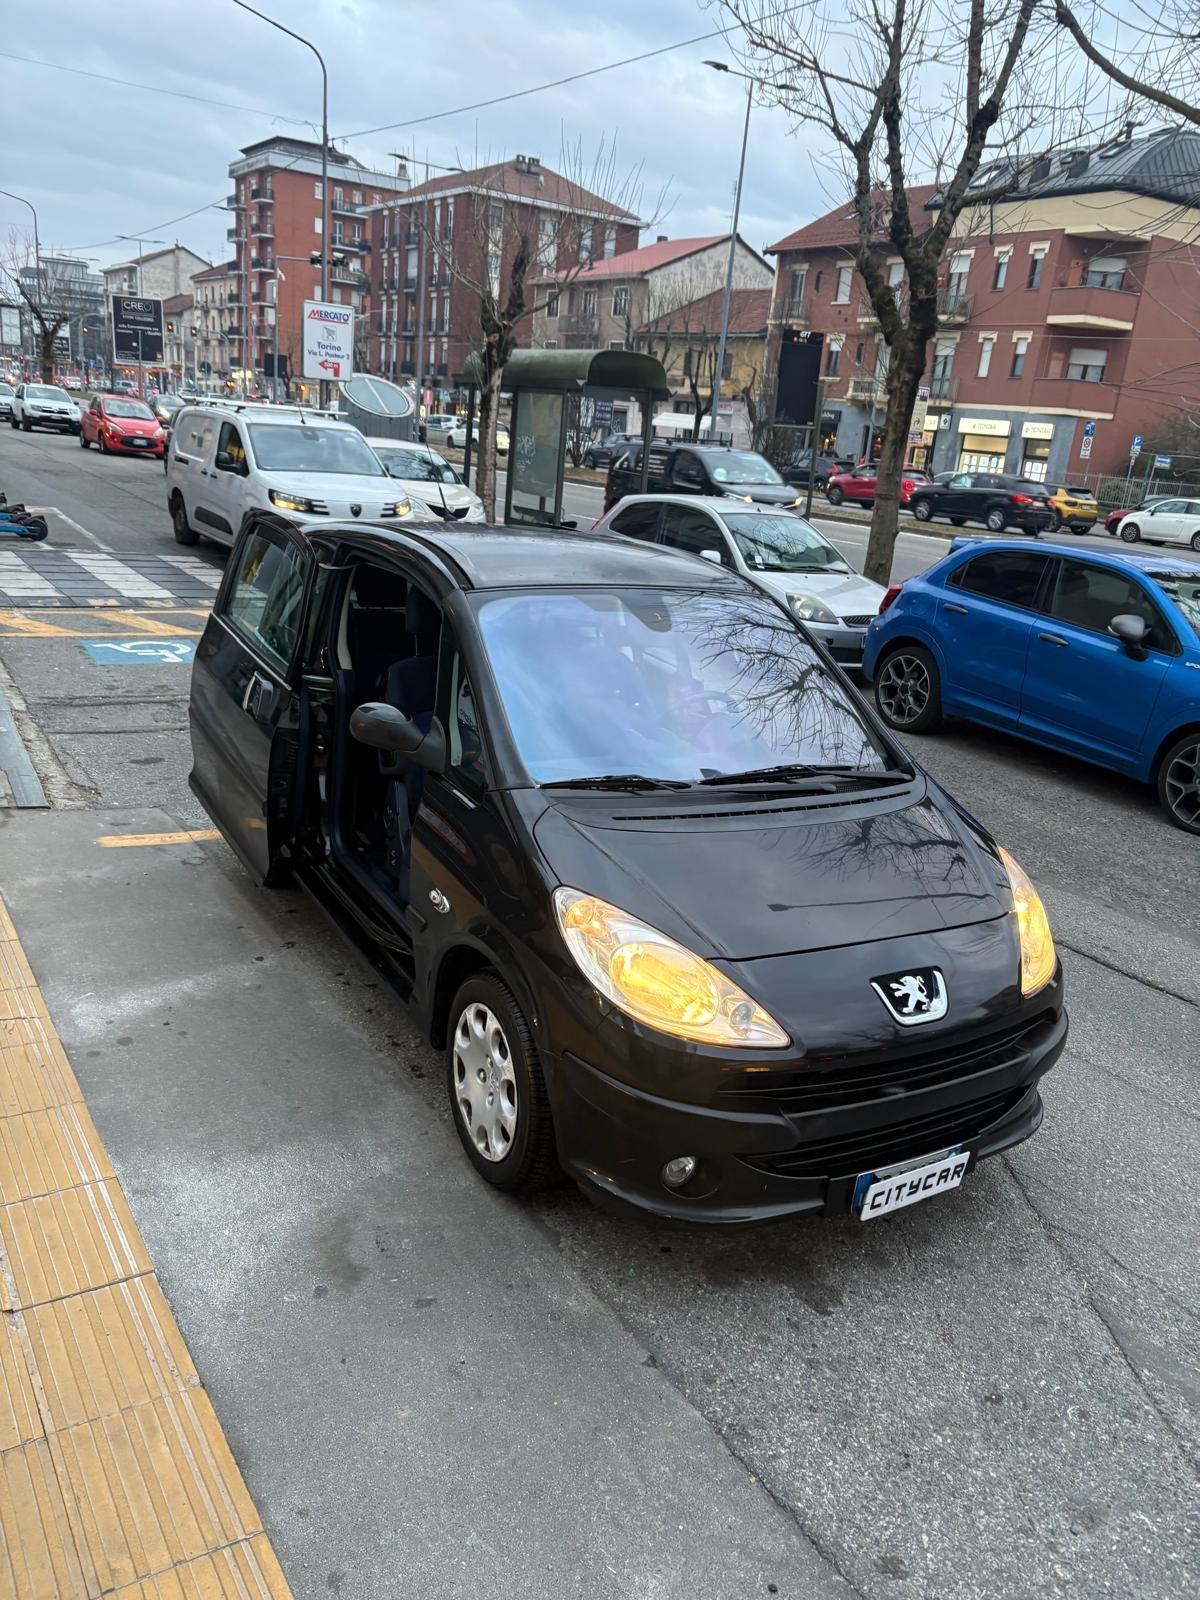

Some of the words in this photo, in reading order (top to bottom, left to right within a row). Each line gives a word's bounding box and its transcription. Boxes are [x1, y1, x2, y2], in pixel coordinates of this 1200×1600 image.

[123, 302, 151, 311] CREO
[317, 341, 342, 352] Torino
[870, 1163, 965, 1210] CITYCAR
